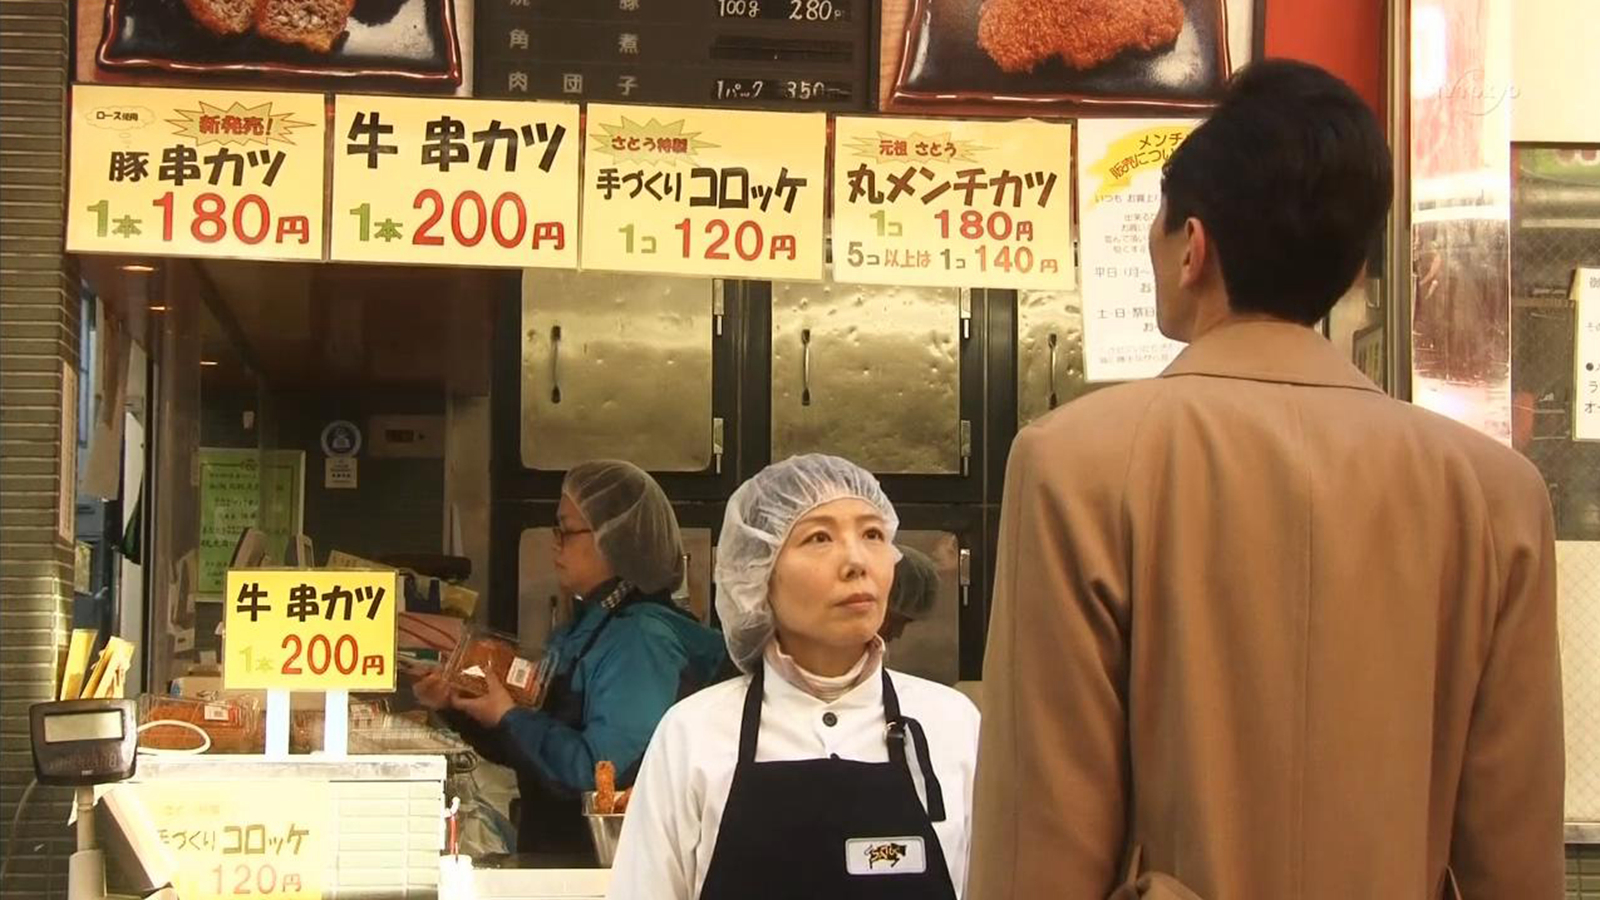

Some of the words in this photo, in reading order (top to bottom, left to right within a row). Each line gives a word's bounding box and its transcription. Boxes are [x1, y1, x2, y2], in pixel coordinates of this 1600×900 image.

[346, 111, 398, 169] 牛
[421, 115, 566, 173] 串カツ
[915, 141, 957, 158] さとう
[847, 162, 1058, 208] 丸メンチカツ
[86, 199, 142, 239] 1本
[152, 191, 310, 245] 180円
[349, 203, 404, 242] 1本
[412, 188, 565, 250] 200円
[618, 223, 657, 254] 1コ
[674, 217, 797, 261] 120円
[868, 209, 903, 237] 1コ
[934, 208, 1034, 241] 180円
[975, 244, 1059, 274] 140円
[236, 582, 271, 622] 牛
[287, 583, 386, 622] 串カツ
[281, 633, 385, 676] 200円
[211, 863, 302, 895] 120円
